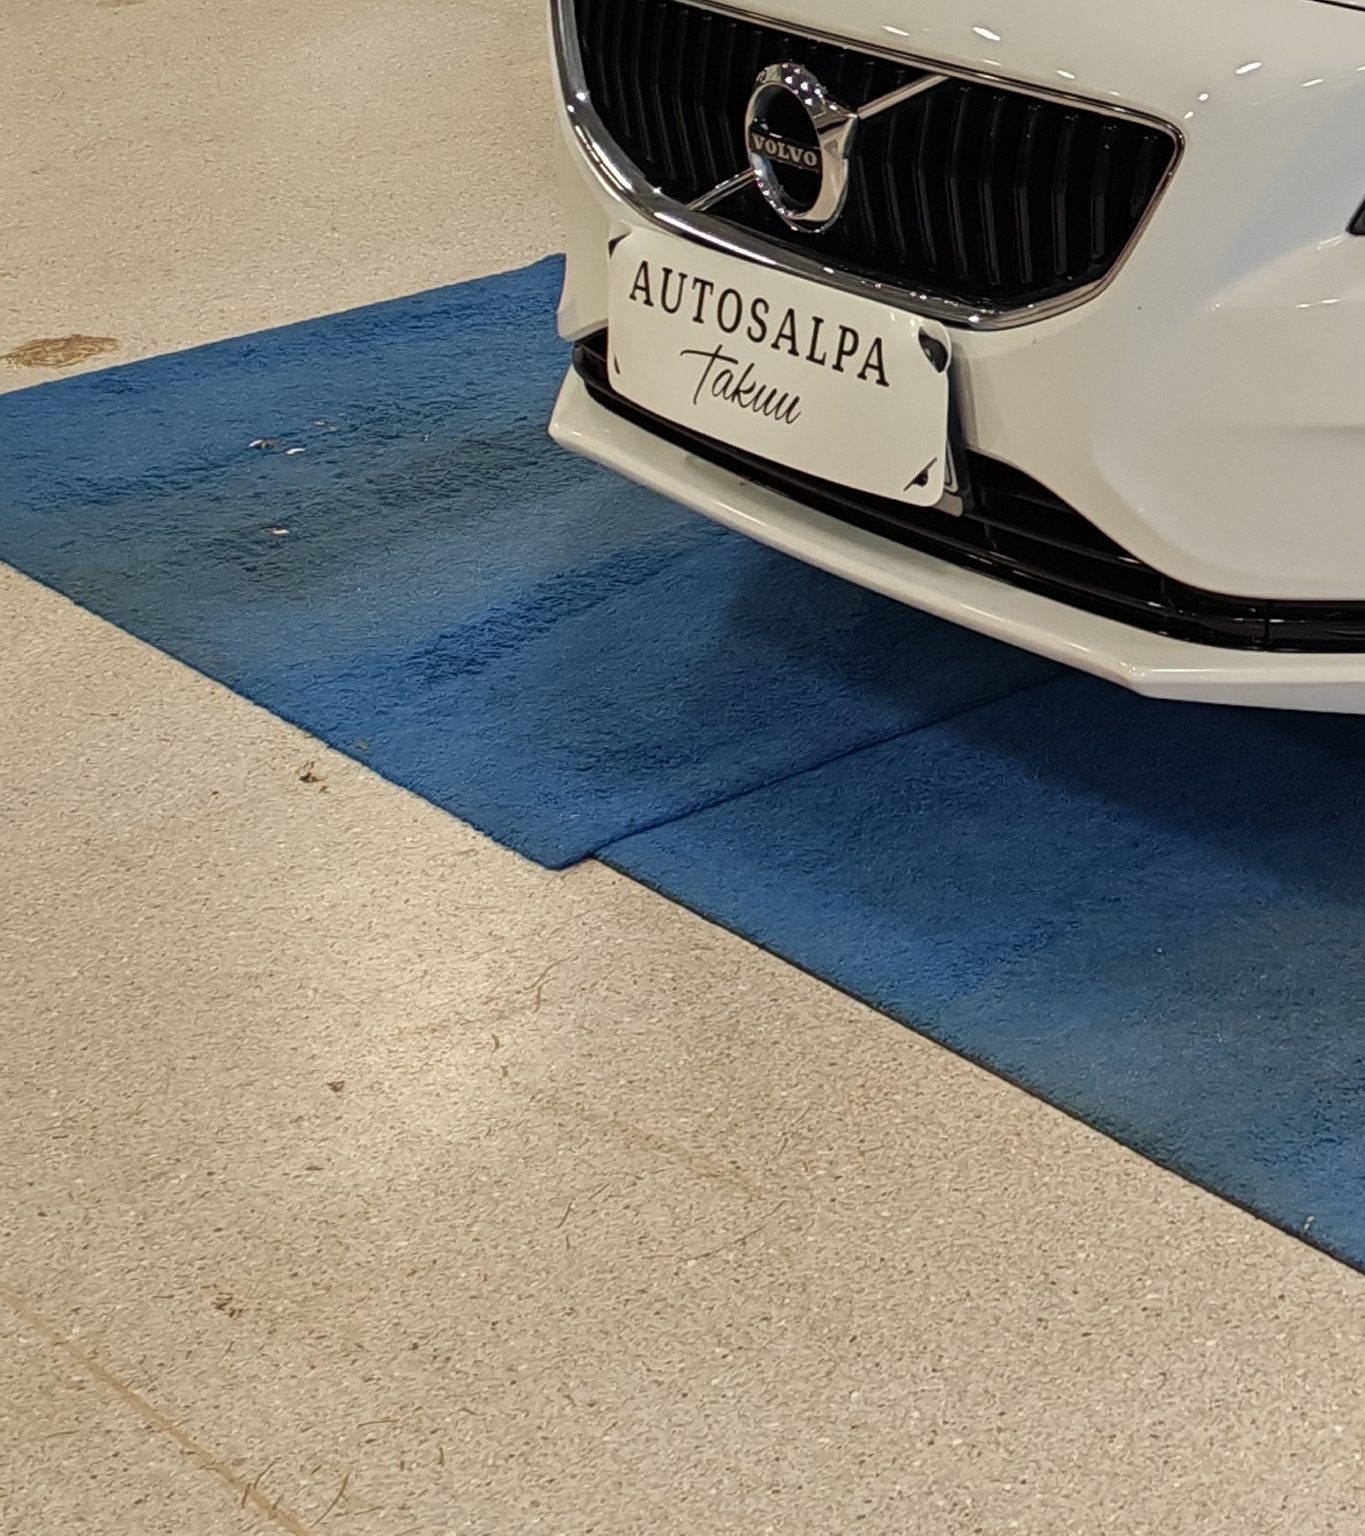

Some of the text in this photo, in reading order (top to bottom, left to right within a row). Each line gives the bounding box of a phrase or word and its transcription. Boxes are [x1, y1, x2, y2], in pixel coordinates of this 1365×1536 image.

[750, 133, 820, 168] VOLVO
[628, 259, 891, 388] AUTOSALPA
[679, 343, 802, 425] Takuu
